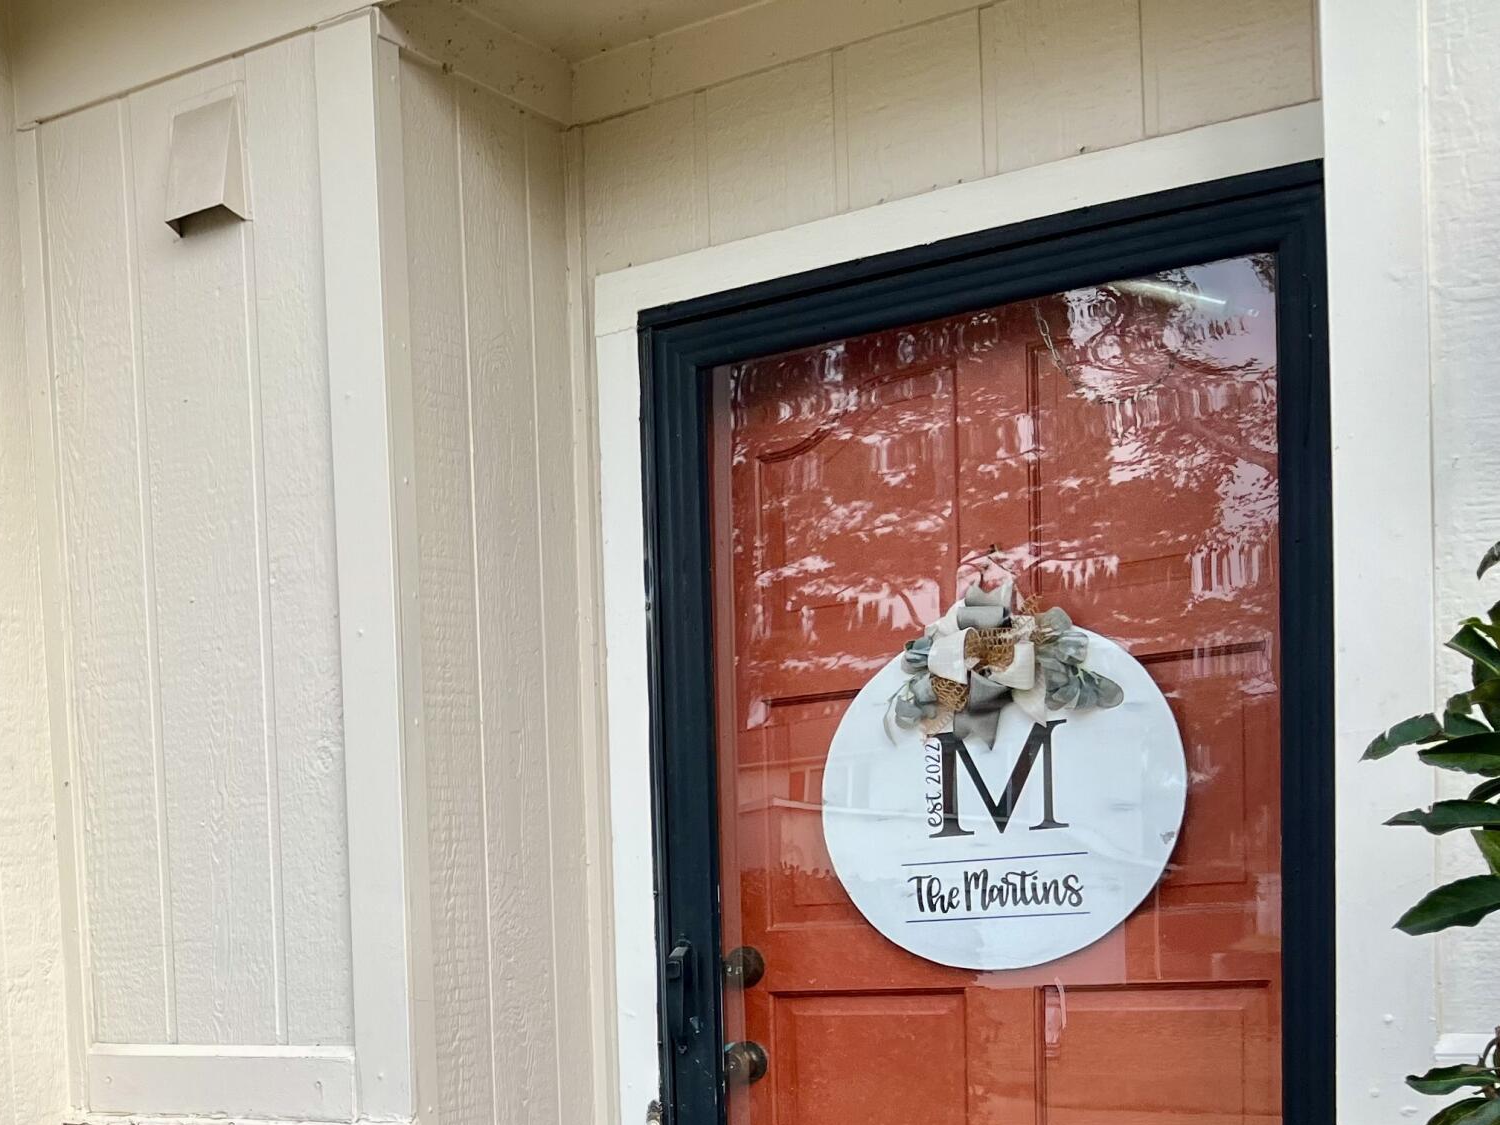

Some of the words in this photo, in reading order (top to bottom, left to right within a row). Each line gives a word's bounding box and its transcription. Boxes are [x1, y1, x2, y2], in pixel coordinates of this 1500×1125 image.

[924, 742, 942, 785] 2022
[927, 719, 1069, 838] M
[907, 874, 960, 914] The
[963, 868, 1084, 912] Martins
